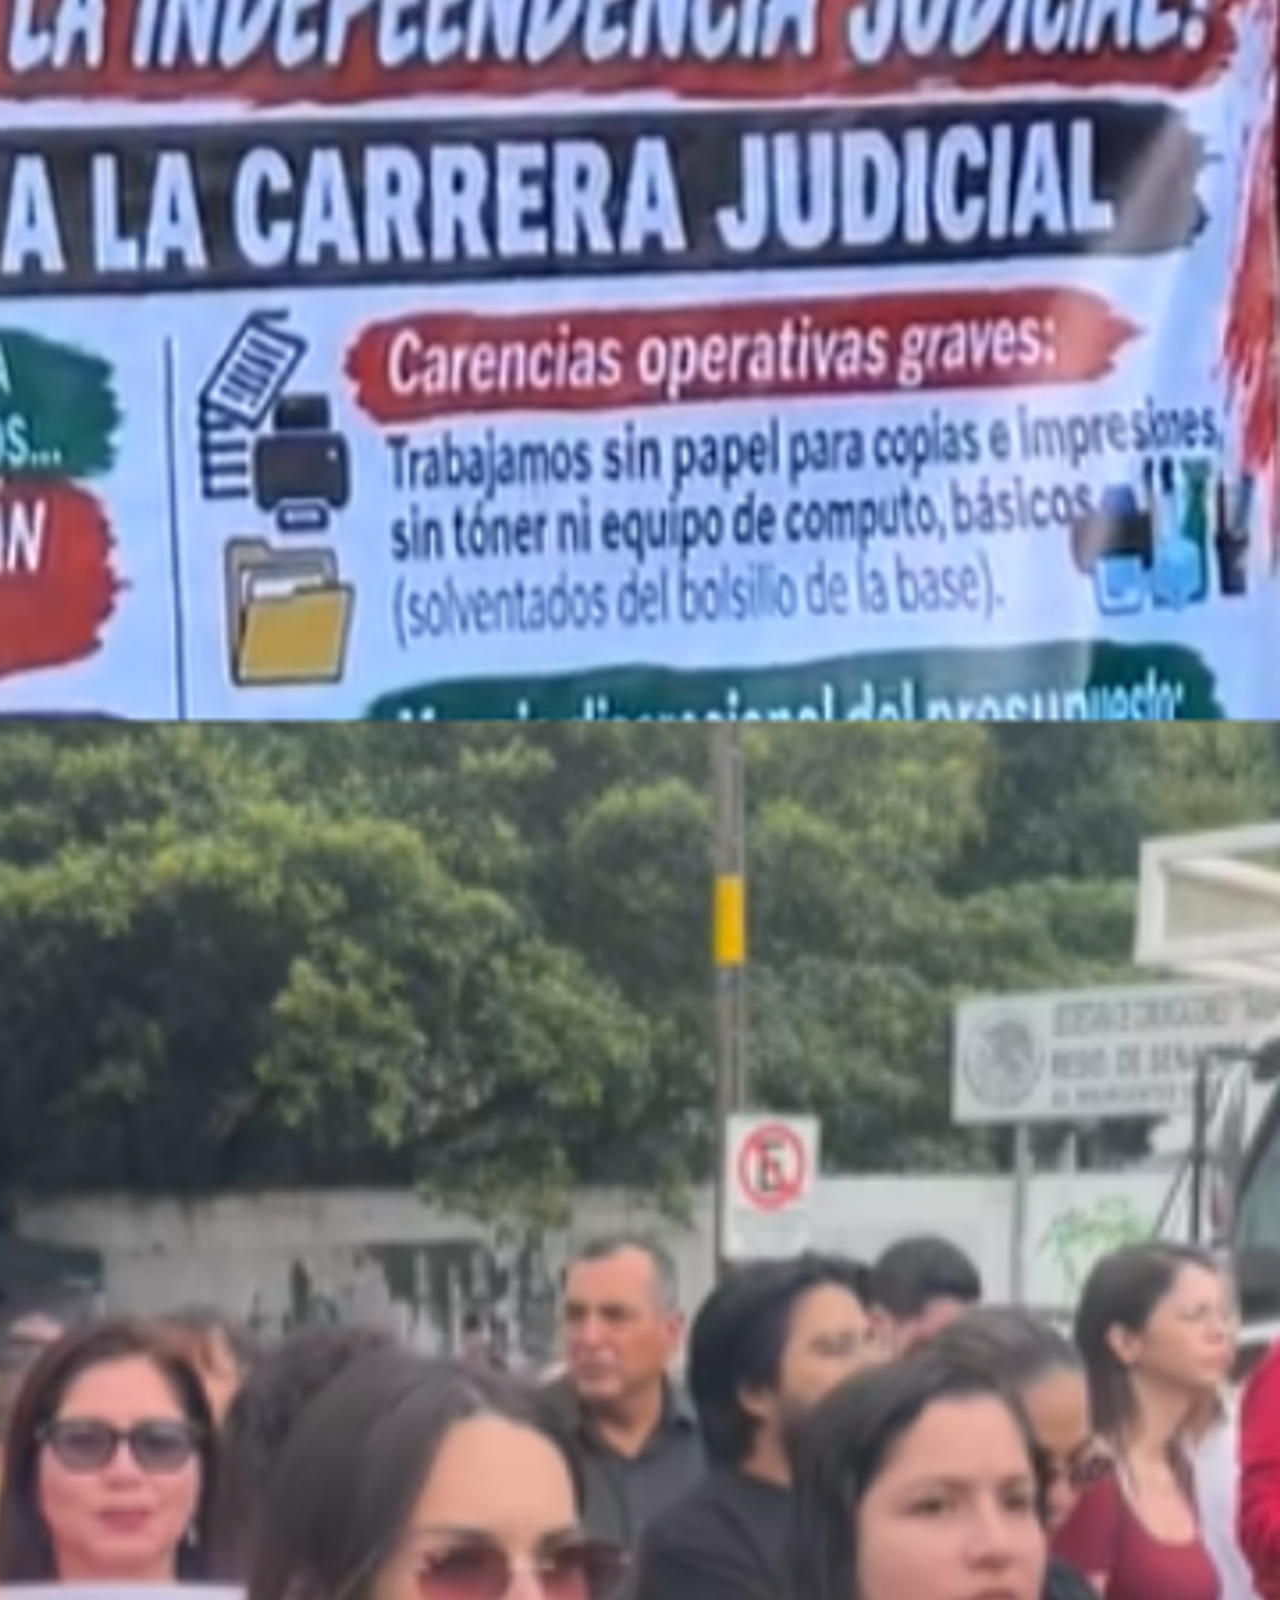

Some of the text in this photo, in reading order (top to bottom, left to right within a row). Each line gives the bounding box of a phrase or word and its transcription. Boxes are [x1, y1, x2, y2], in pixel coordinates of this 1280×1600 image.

[0, 154, 89, 276] A
[93, 148, 208, 273] LA
[232, 136, 687, 269] CARRERA
[716, 119, 1116, 252] JUDICIAL
[386, 316, 1057, 400] Carencias operativas graves:
[384, 429, 593, 501] Trabajamos
[602, 421, 662, 479] sin
[673, 417, 780, 493] papel
[789, 426, 865, 486] para
[873, 410, 981, 477] copias
[988, 420, 1012, 458] e
[390, 508, 445, 561] sin
[454, 506, 549, 559] tóner
[557, 498, 591, 554] ni
[600, 493, 725, 564] equipo
[732, 491, 777, 544] de
[392, 573, 610, 649] (solventados
[617, 567, 670, 624] del
[805, 558, 849, 616] de
[856, 555, 889, 614] la
